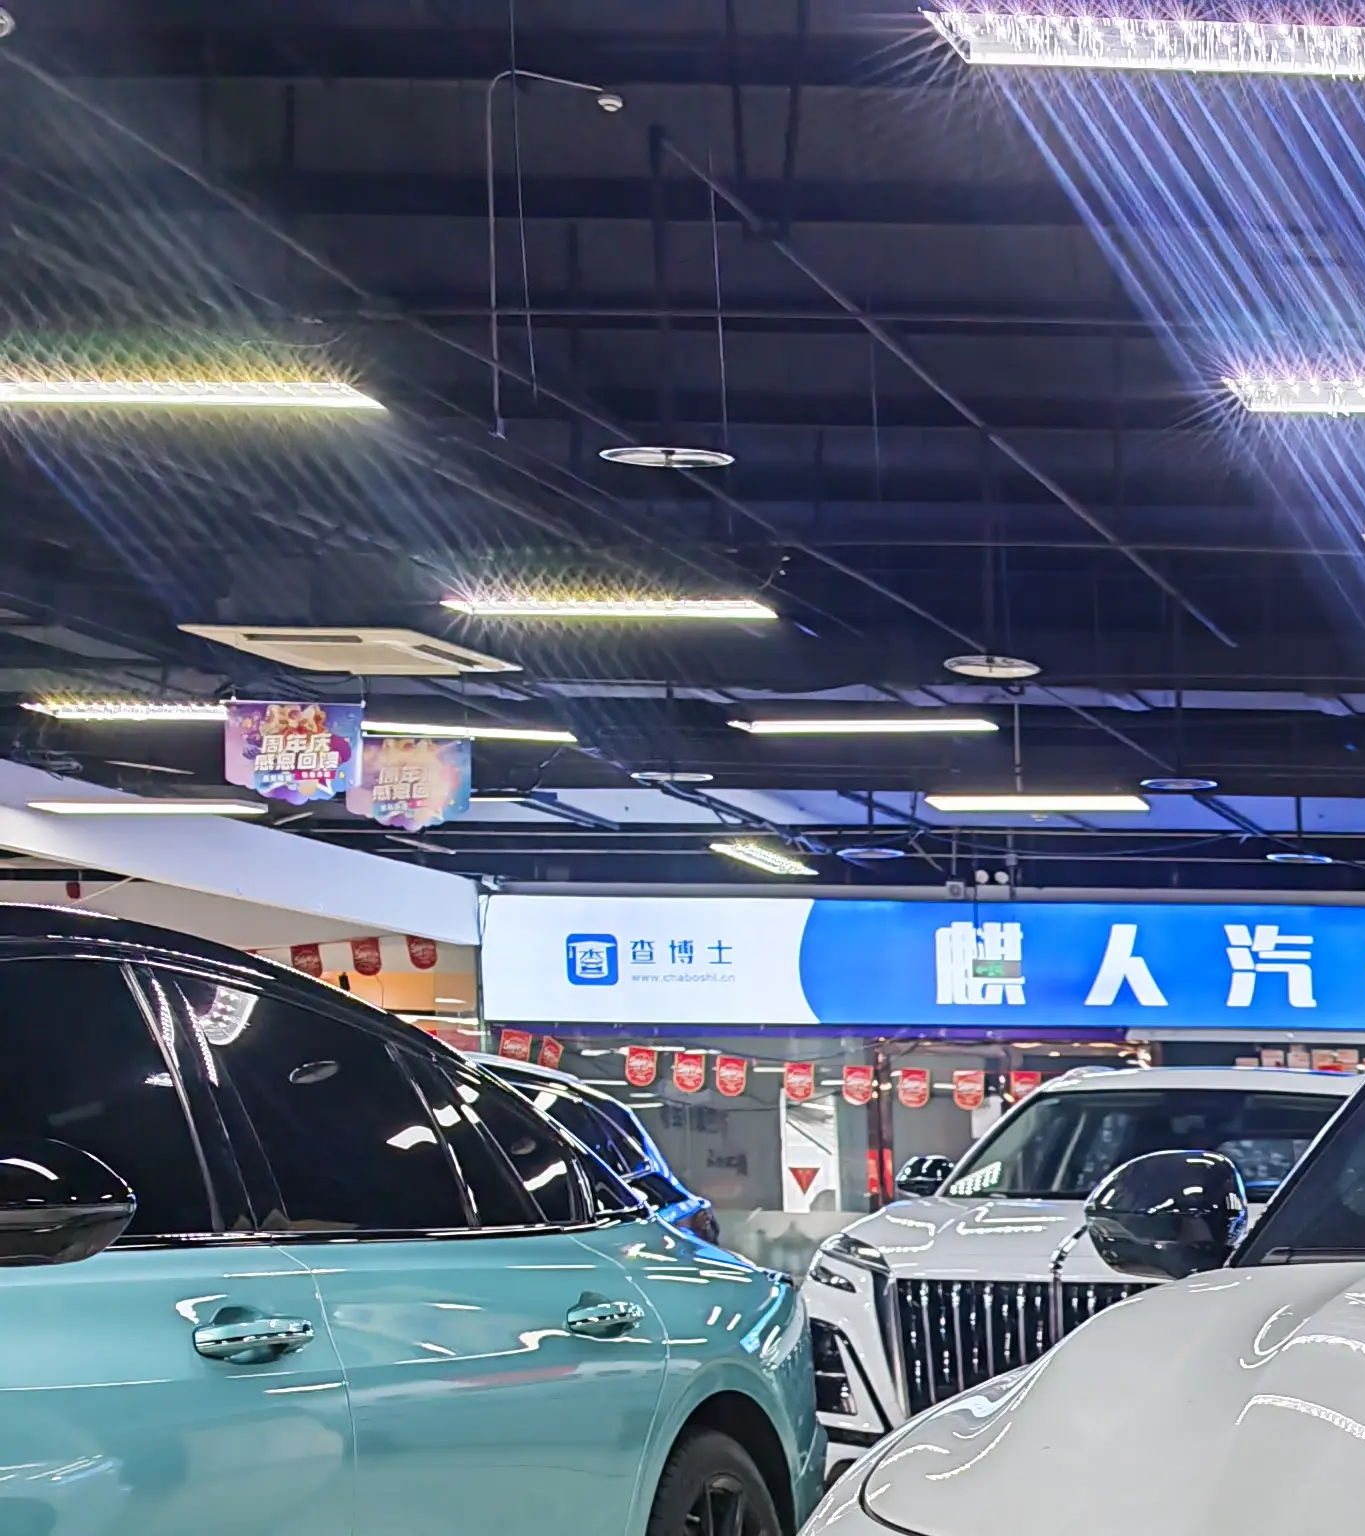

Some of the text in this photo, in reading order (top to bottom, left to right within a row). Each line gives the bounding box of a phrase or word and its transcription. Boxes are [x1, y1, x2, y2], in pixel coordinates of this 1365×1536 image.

[260, 732, 331, 753] 周年庆
[630, 939, 733, 965] 查博士
[630, 972, 736, 983] www.chaboshi.cn
